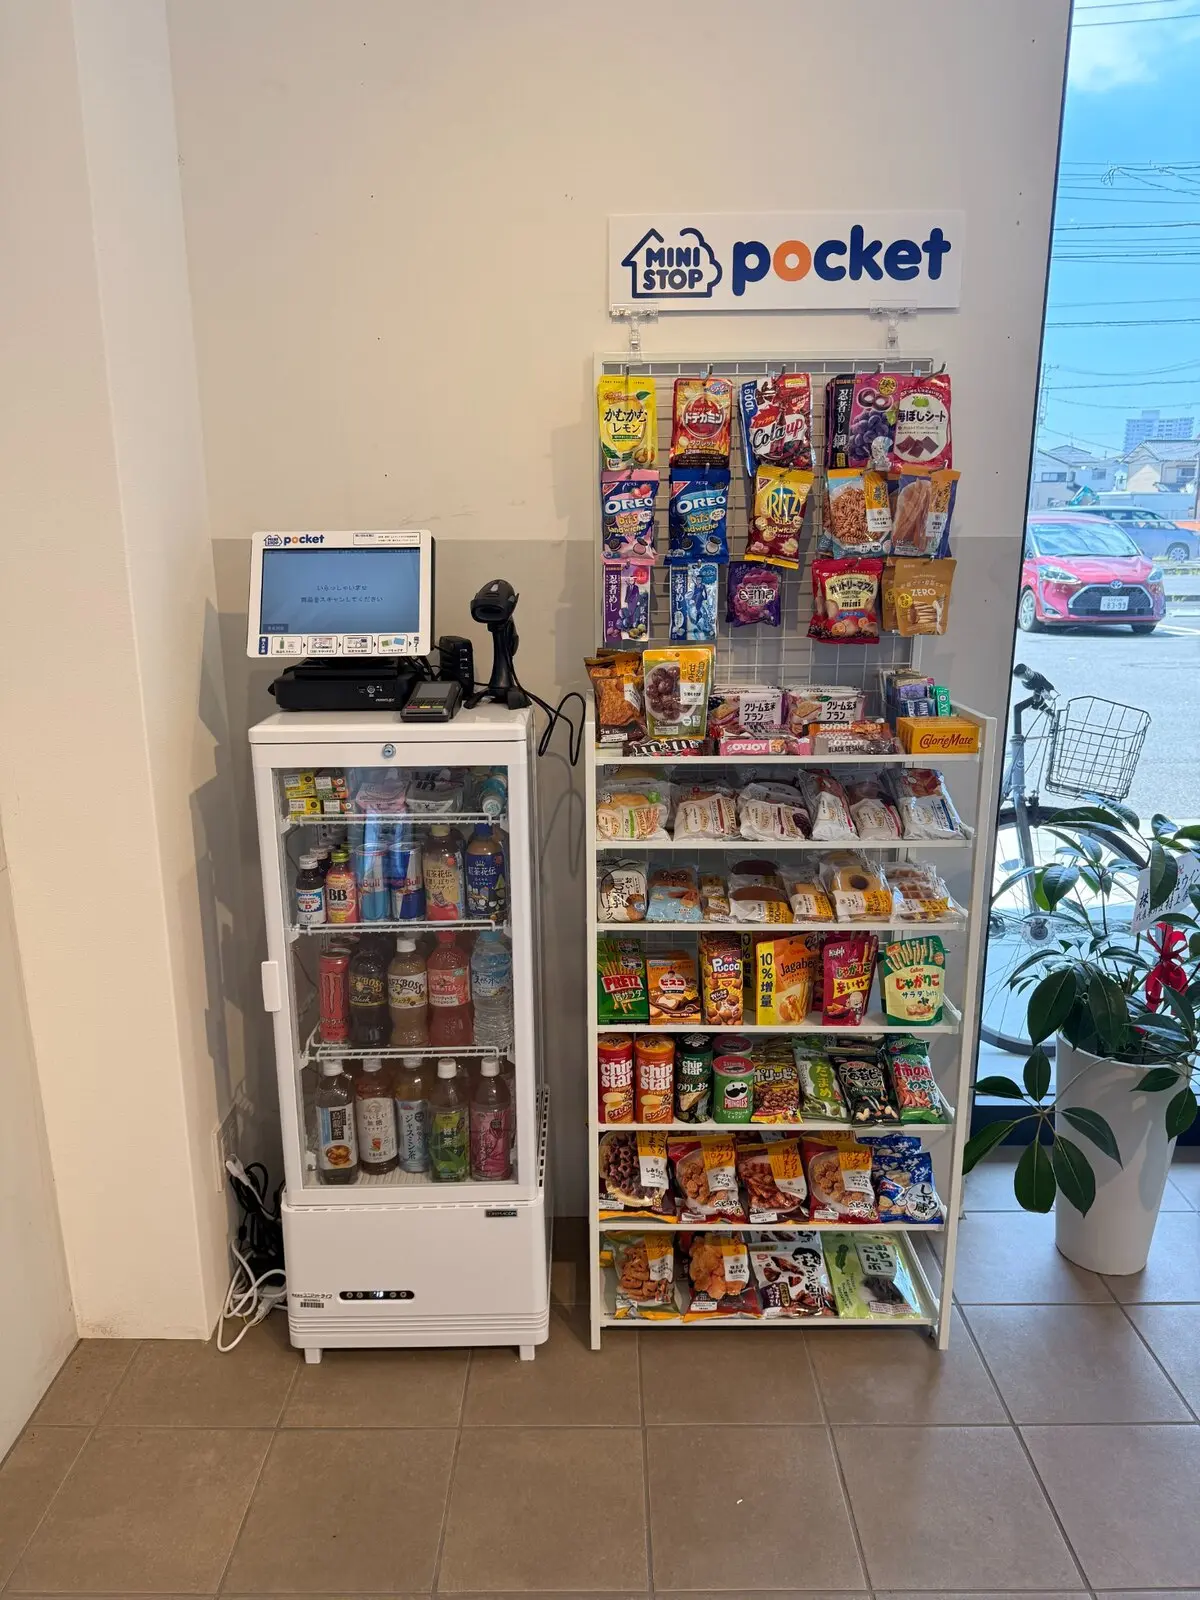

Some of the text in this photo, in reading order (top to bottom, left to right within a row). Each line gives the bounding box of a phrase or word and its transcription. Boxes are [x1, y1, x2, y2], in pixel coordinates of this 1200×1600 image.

[645, 246, 701, 268] MINI
[732, 224, 952, 297] pocket
[643, 268, 704, 290] STOP
[604, 408, 648, 423] かむかむ
[684, 411, 723, 424] ドデカミン
[613, 423, 641, 433] レモン
[753, 423, 786, 448] Cola
[785, 417, 804, 434] up
[605, 498, 653, 515] OREO
[676, 496, 727, 515] OREO
[768, 490, 801, 519] RITZ
[690, 513, 709, 525] bits
[283, 534, 325, 546] pocket
[608, 574, 618, 611] 忍者めし
[675, 573, 684, 611] 忍者めし
[829, 580, 875, 595] カントリーマアム
[911, 588, 937, 597] ZERO
[841, 599, 861, 608] mini
[744, 702, 775, 712] クリーム玄米
[826, 701, 857, 710] クリーム玄米
[744, 712, 764, 721] ブラン
[826, 711, 846, 720] ブラン
[919, 733, 974, 749] CalorieMate
[329, 889, 348, 901] BB
[711, 957, 740, 972] Pucca
[780, 956, 816, 977] Jagabee
[836, 961, 871, 978] じゃがりこ
[400, 978, 424, 995] BOSS
[603, 976, 641, 991] PRETZ
[660, 978, 685, 987] ビスコ
[895, 972, 940, 990] じゃがりこ
[901, 991, 924, 1000] サラダ
[601, 1058, 632, 1075] chip
[640, 1063, 673, 1079] chip
[682, 1060, 703, 1071] chip
[682, 1066, 704, 1076] star
[601, 1073, 633, 1088] star
[640, 1075, 673, 1091] star
[724, 1097, 748, 1109] PRINGLES
[405, 1113, 416, 1160] ジャスミン茶
